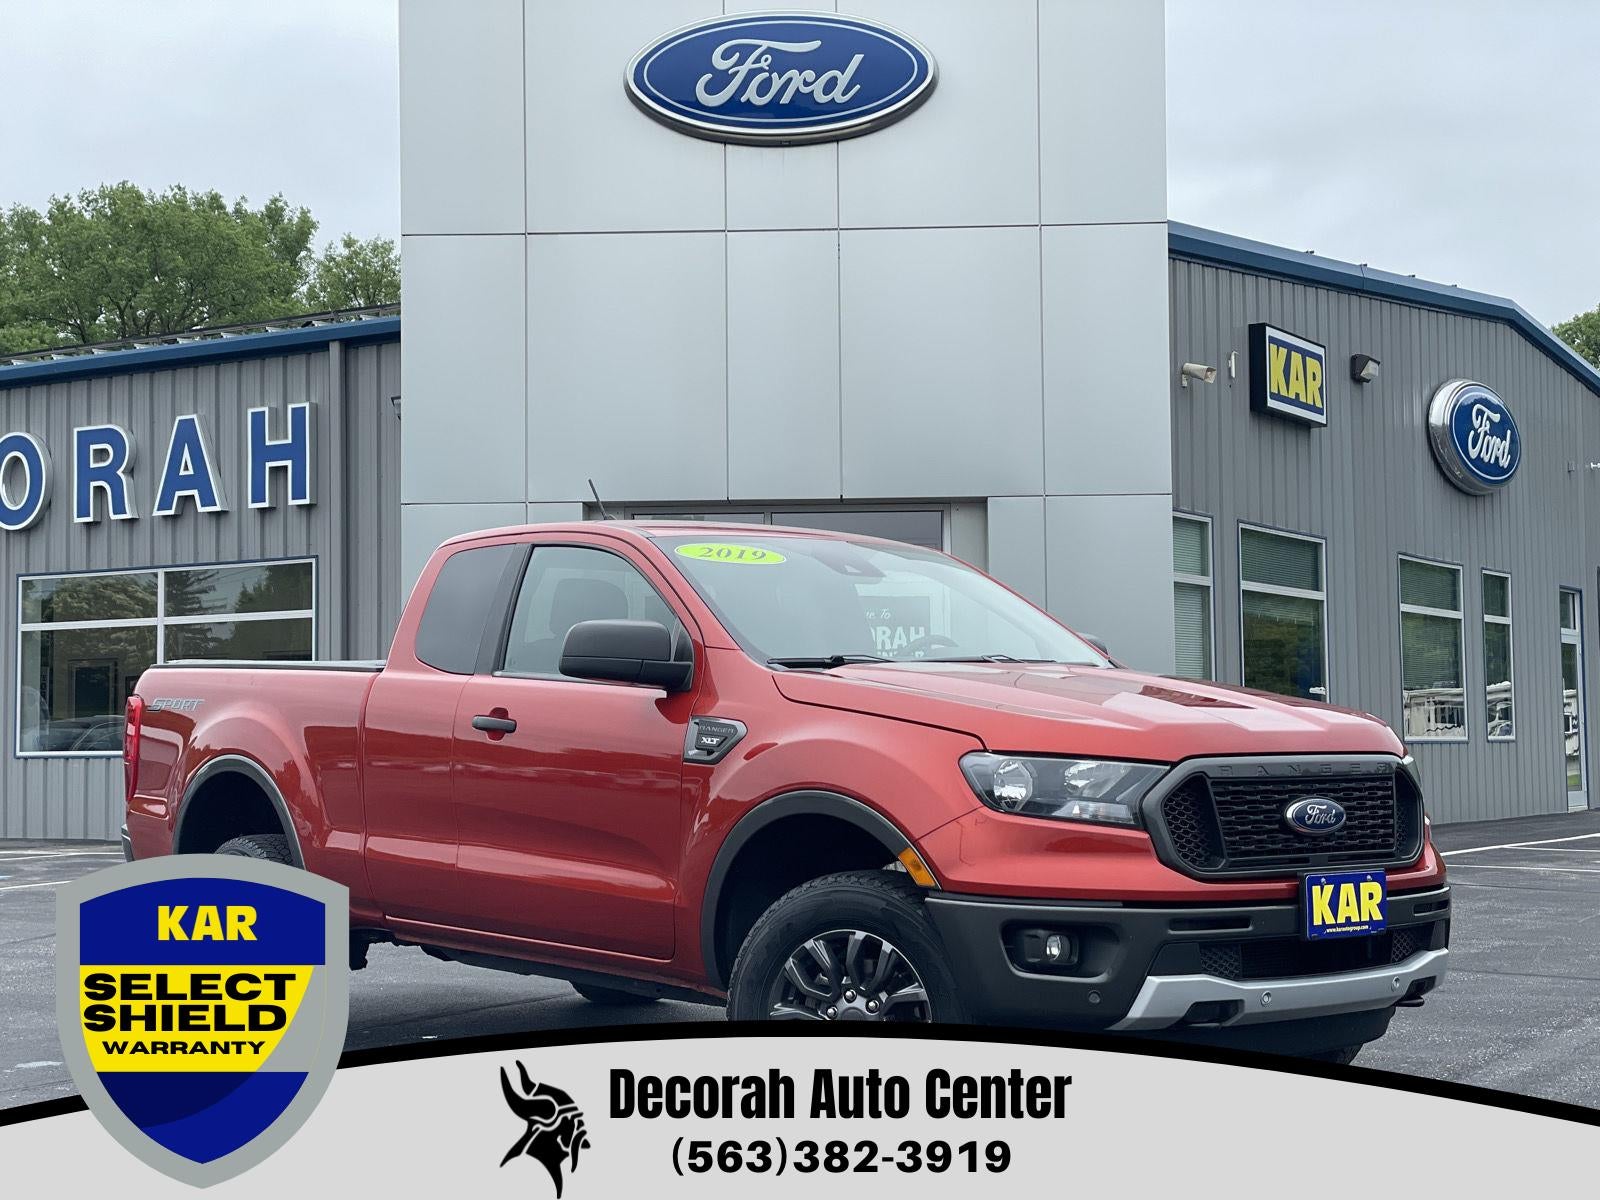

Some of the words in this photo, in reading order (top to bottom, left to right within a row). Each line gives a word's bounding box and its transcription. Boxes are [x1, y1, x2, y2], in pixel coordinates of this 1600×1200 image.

[695, 39, 865, 107] Ford
[1268, 343, 1324, 409] KAR
[1467, 403, 1512, 469] Ford
[0, 401, 317, 531] ORAH
[698, 547, 767, 560] 2019
[880, 608, 891, 619] To
[869, 626, 925, 650] RAH
[146, 698, 205, 712] SPORT
[701, 736, 719, 745] XLT
[1218, 762, 1391, 777] RANGER
[1305, 804, 1336, 824] Ford
[1312, 881, 1383, 926] KAR
